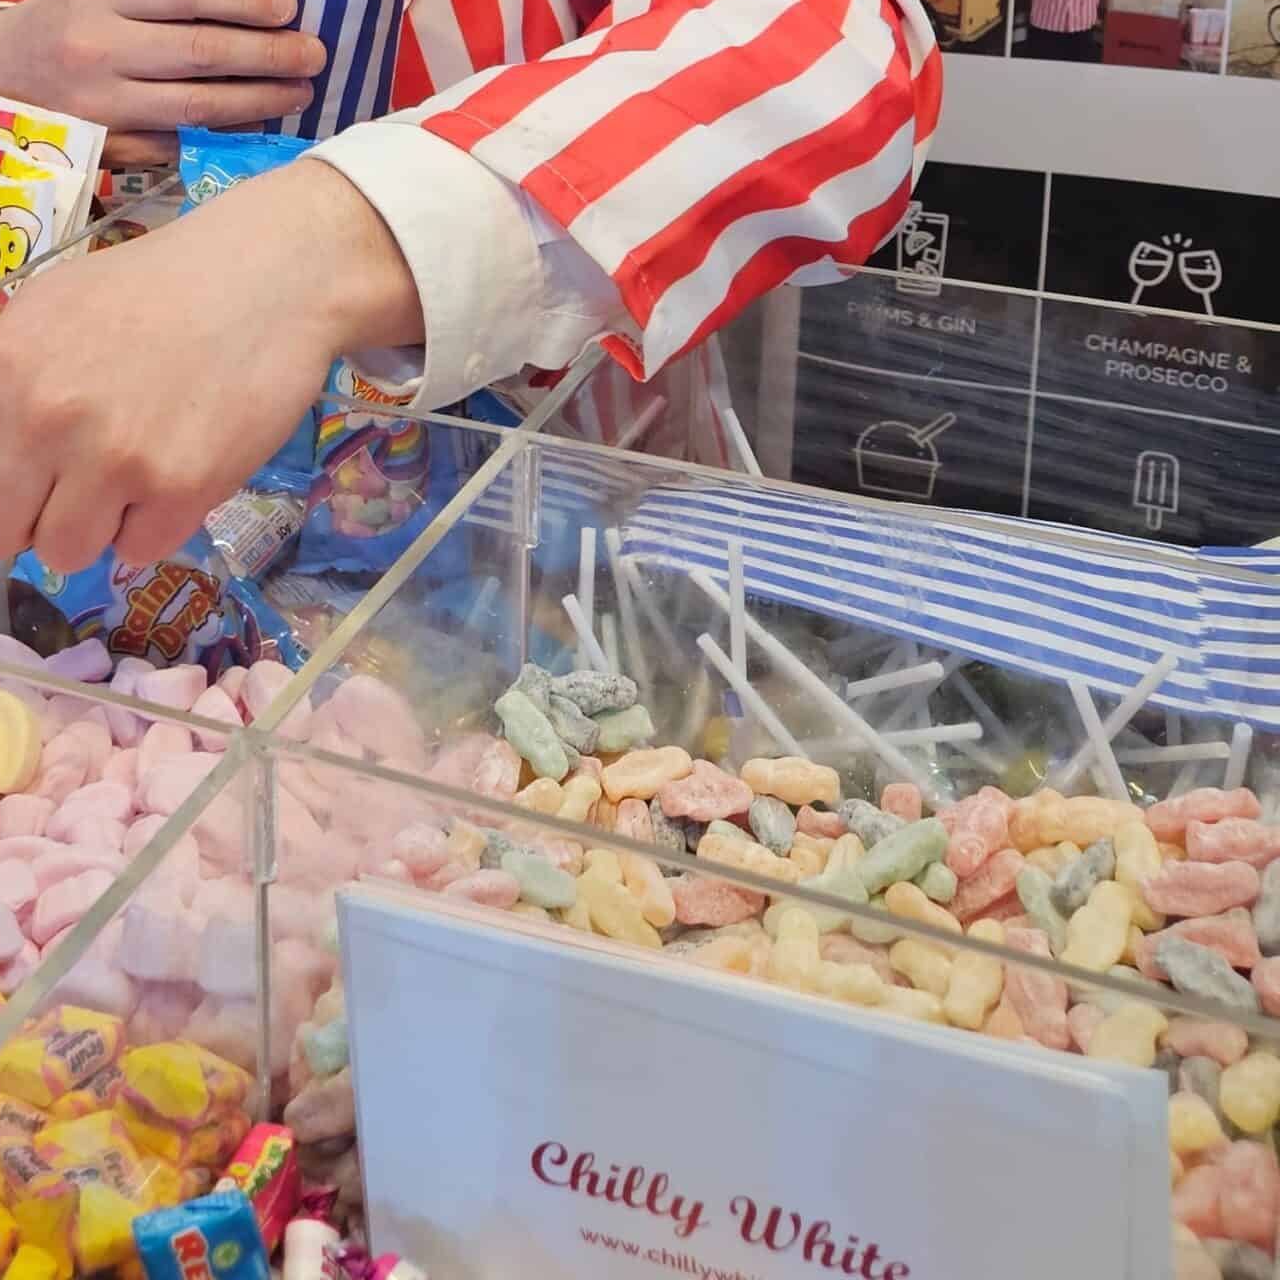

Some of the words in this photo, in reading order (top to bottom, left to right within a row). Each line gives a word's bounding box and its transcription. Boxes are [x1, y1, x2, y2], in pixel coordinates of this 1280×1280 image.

[938, 314, 977, 335] GIN
[1085, 333, 1231, 370] CHAMPAGNE
[1236, 353, 1253, 374] &
[1105, 358, 1228, 393] PROSECCO
[531, 1140, 710, 1238] Chilly
[729, 1195, 912, 1280] White
